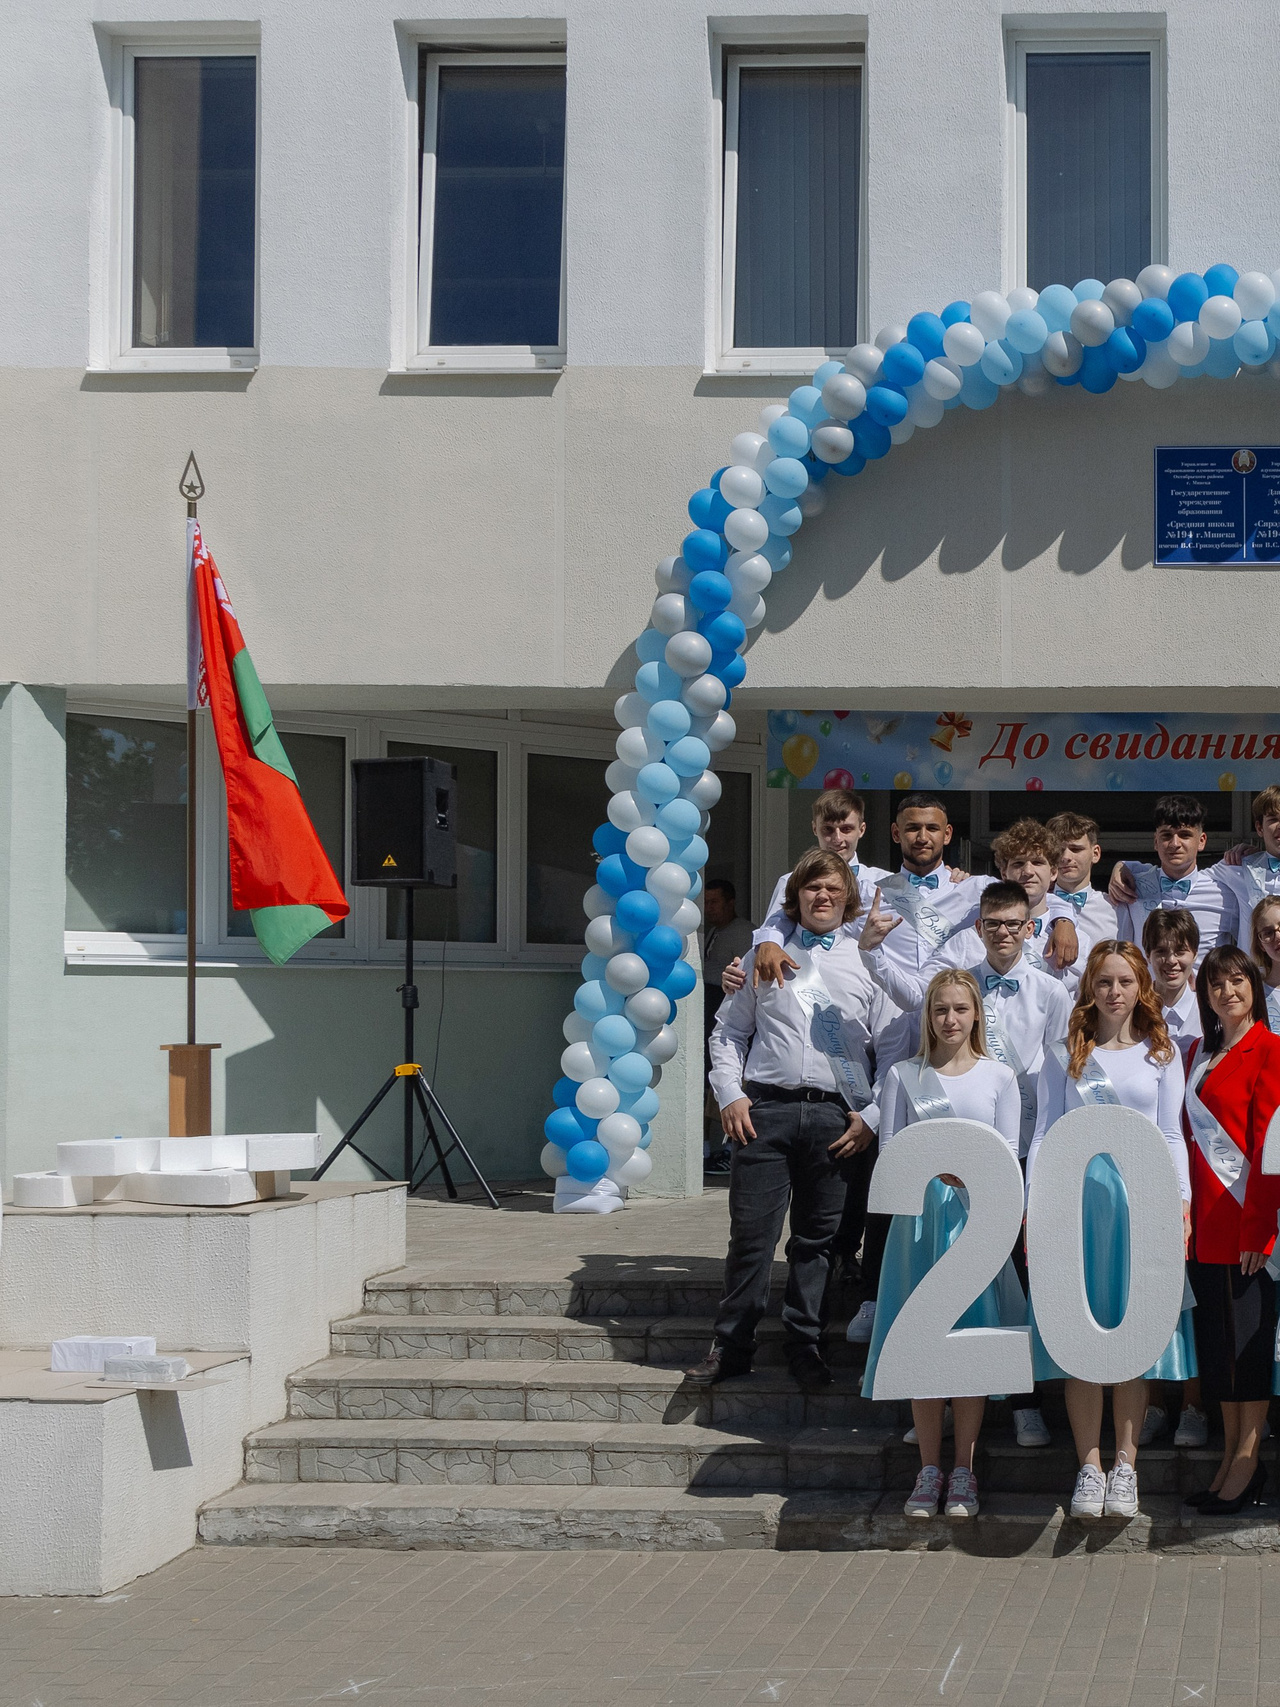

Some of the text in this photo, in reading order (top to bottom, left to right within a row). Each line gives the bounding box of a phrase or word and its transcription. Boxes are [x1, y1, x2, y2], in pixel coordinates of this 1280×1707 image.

[1170, 489, 1230, 497] Государственное
[1178, 508, 1223, 516] образования
[1165, 530, 1193, 539] №194
[978, 722, 1050, 769] До
[817, 1010, 859, 1093] Выпускник
[1208, 1137, 1243, 1173] 2024
